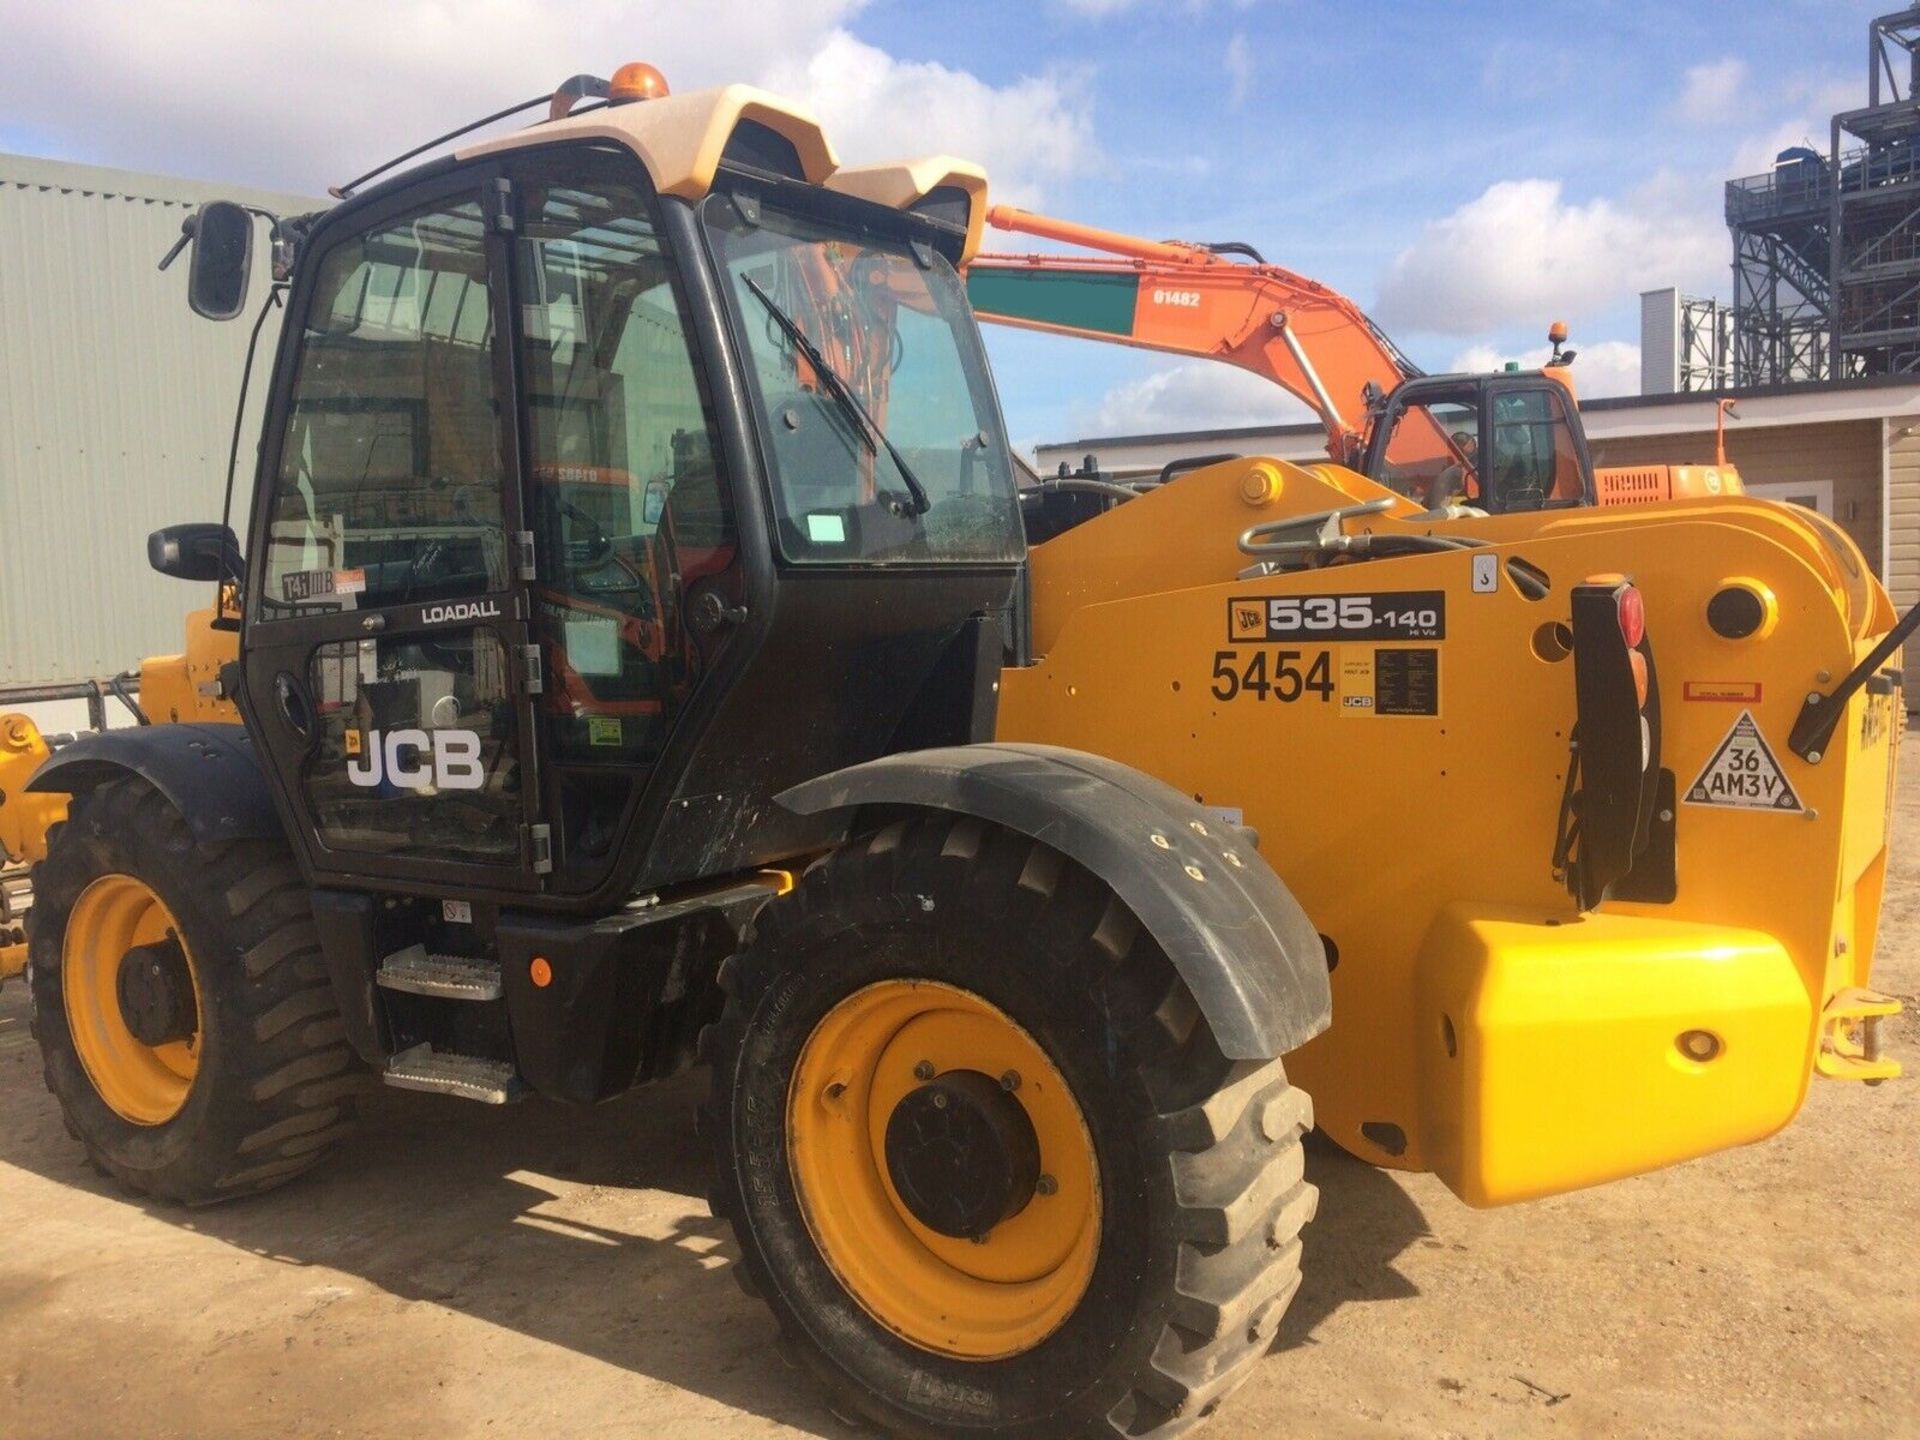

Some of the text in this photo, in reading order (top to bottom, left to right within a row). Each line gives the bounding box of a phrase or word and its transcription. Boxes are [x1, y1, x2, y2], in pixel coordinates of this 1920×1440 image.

[422, 601, 501, 624] LOADALL
[1240, 610, 1262, 628] JCB
[1211, 651, 1335, 702] 5454
[1344, 696, 1372, 707] JCB
[347, 729, 485, 789] JCB
[1728, 748, 1760, 771] 36
[1710, 772, 1777, 798] AM3Y
